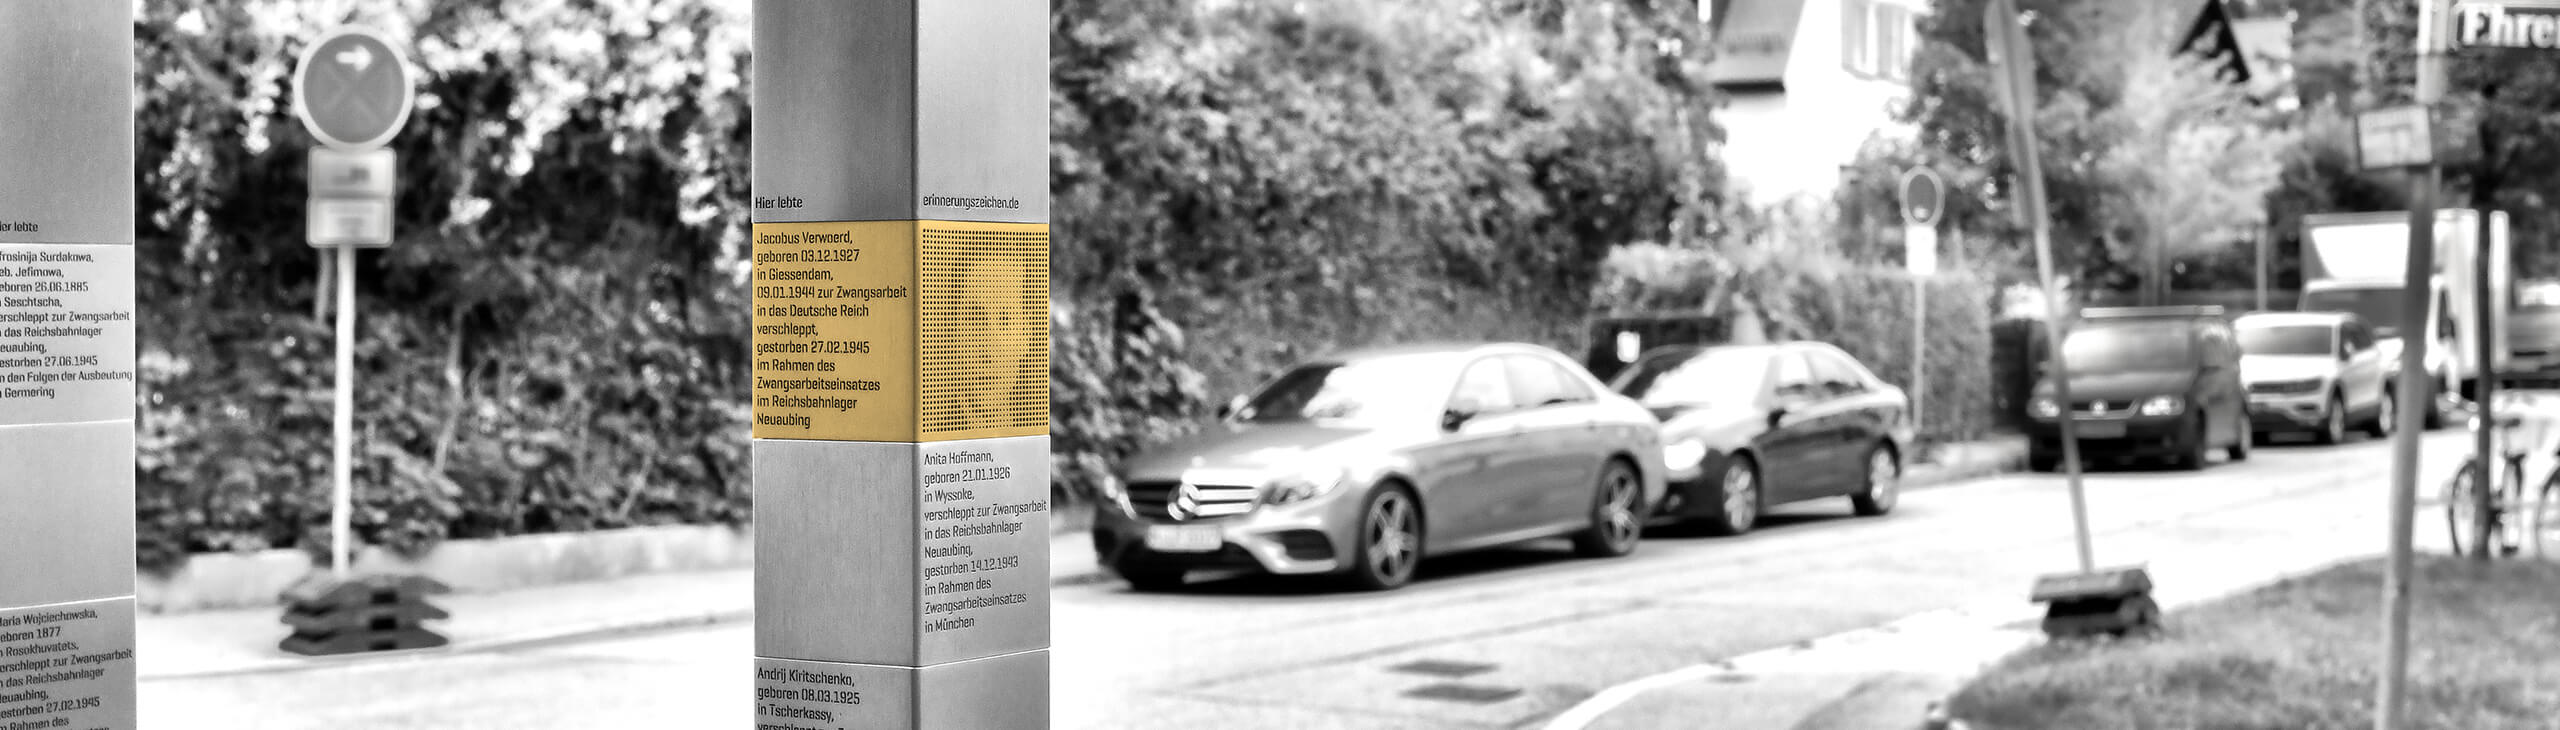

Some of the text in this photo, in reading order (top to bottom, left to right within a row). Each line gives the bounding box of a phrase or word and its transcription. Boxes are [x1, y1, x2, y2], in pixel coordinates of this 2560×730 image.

[2462, 5, 2560, 47] Ehre
[755, 196, 803, 209] Hier lebte
[923, 193, 1019, 210] erinnerungszeichen.de
[14, 221, 39, 232] lebte
[756, 231, 853, 244] Jacobus Verwoerd,
[757, 249, 860, 266] geboren 03.12.1927
[15, 266, 64, 278] Jefimowa,
[757, 268, 834, 282] in Giessendam,
[34, 281, 88, 292] 26.06.1885
[757, 286, 907, 301] 09.01.1944 zur Zwangsarbeit
[51, 313, 66, 322] zur
[69, 311, 130, 324] Zwangsarbeit
[757, 304, 869, 317] in das Deutsche Reich
[4, 326, 22, 338] das
[24, 326, 103, 338] Reichsbahnlager
[757, 322, 818, 337] verschleppt,
[757, 340, 870, 356] gestorben 27.02.1945
[44, 355, 98, 367] 27.06.1945
[757, 358, 836, 372] im Rahmen des
[7, 372, 25, 383] den
[27, 371, 59, 384] Folgen
[61, 371, 76, 381] der
[79, 370, 133, 382] Ausbeutung
[757, 377, 881, 392] Zwangsarbeitseinsatzes
[4, 386, 55, 399] Germering
[757, 395, 858, 412] im Reichsbahnlager
[757, 413, 811, 430] Neuaubing
[924, 450, 994, 465] Anita Hoffmann,
[924, 466, 1011, 488] geboren 21.01.1926
[924, 488, 975, 504] in Wyssoke,
[924, 500, 1047, 522] verschleppt zur Zwangsarbeit
[924, 520, 1023, 540] in das Reichsbahnlager
[924, 543, 974, 558] Neuaubing,
[924, 555, 1019, 580] gestorben 14.12.1943
[924, 577, 992, 596] im Rahmen des
[924, 593, 1027, 615] Zwangsarbeitseinsatzes
[23, 608, 98, 626] Wojciechowska,
[924, 616, 974, 633] in München
[37, 626, 61, 640] 1877
[53, 658, 68, 668] zur
[70, 648, 133, 666] Zwangsarbeit
[6, 676, 24, 688] das
[26, 668, 104, 686] Reichsbahnlager
[757, 667, 855, 688] Andrij Kiritschenko,
[757, 686, 860, 704] geboren 08.03.1925
[46, 696, 100, 714] 27.02.1945
[757, 702, 834, 724] in Tscherkassy,
[52, 716, 70, 728] des
